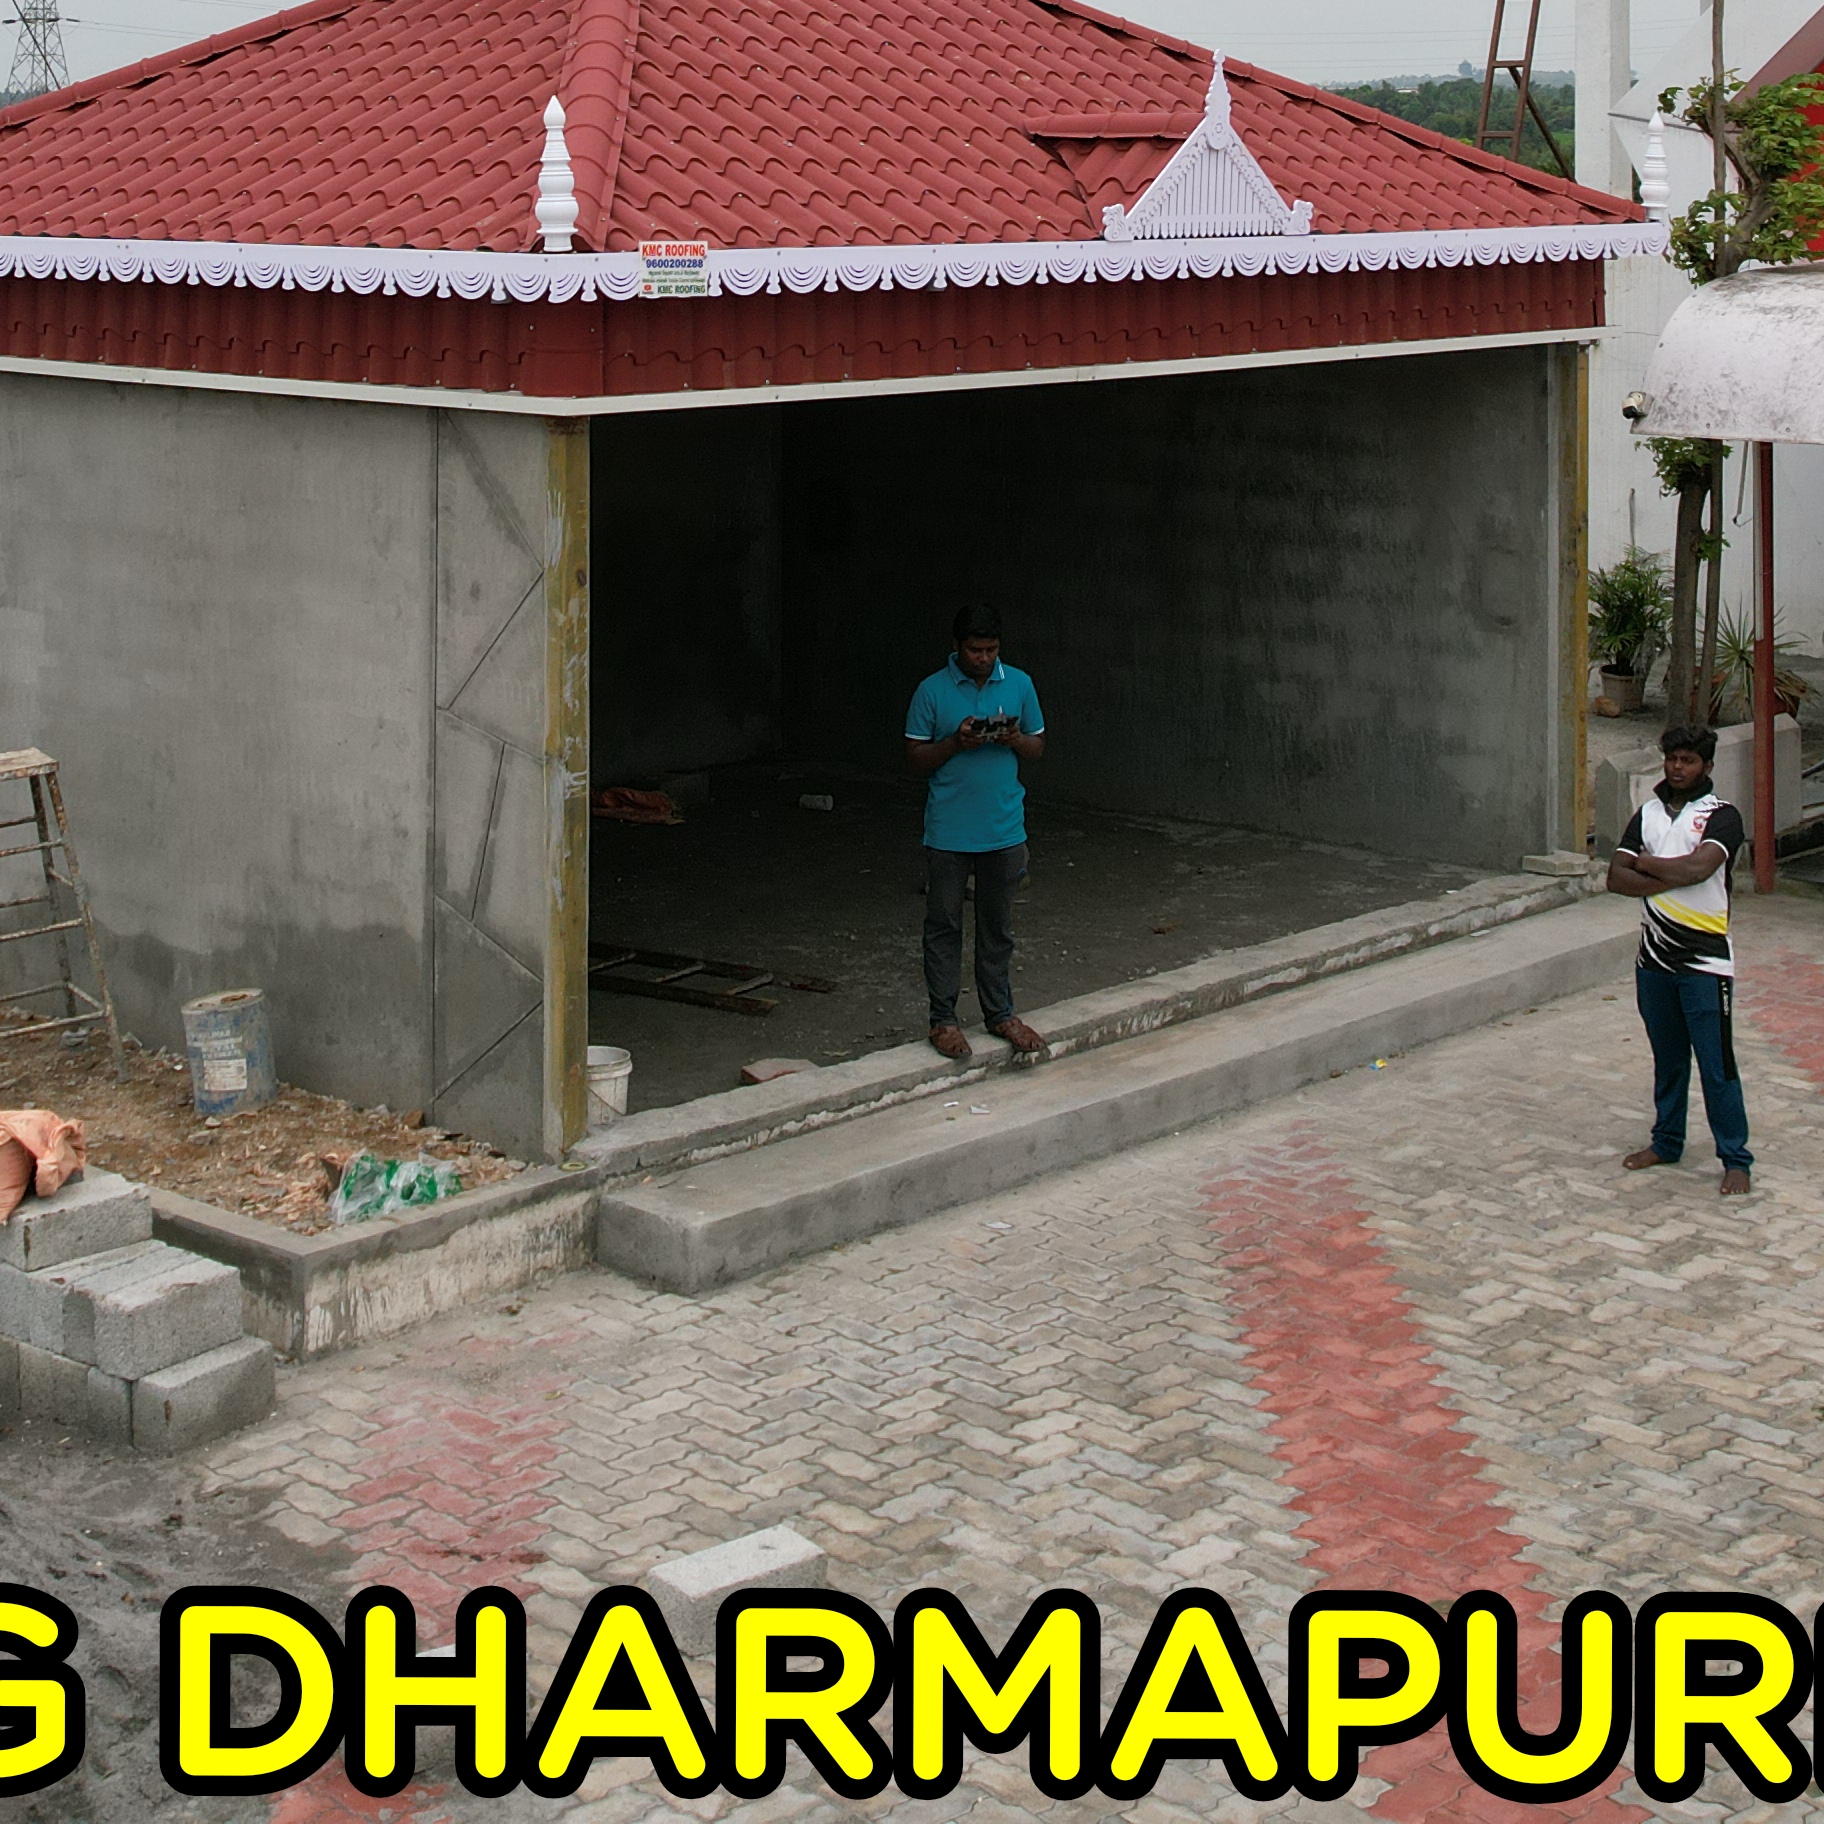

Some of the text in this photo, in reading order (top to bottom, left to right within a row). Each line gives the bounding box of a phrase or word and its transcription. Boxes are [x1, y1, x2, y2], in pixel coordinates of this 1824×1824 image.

[642, 244, 705, 256] KMC ROOFING
[646, 259, 703, 268] 9600200288
[657, 285, 673, 294] KMC
[675, 285, 706, 294] ROOFING
